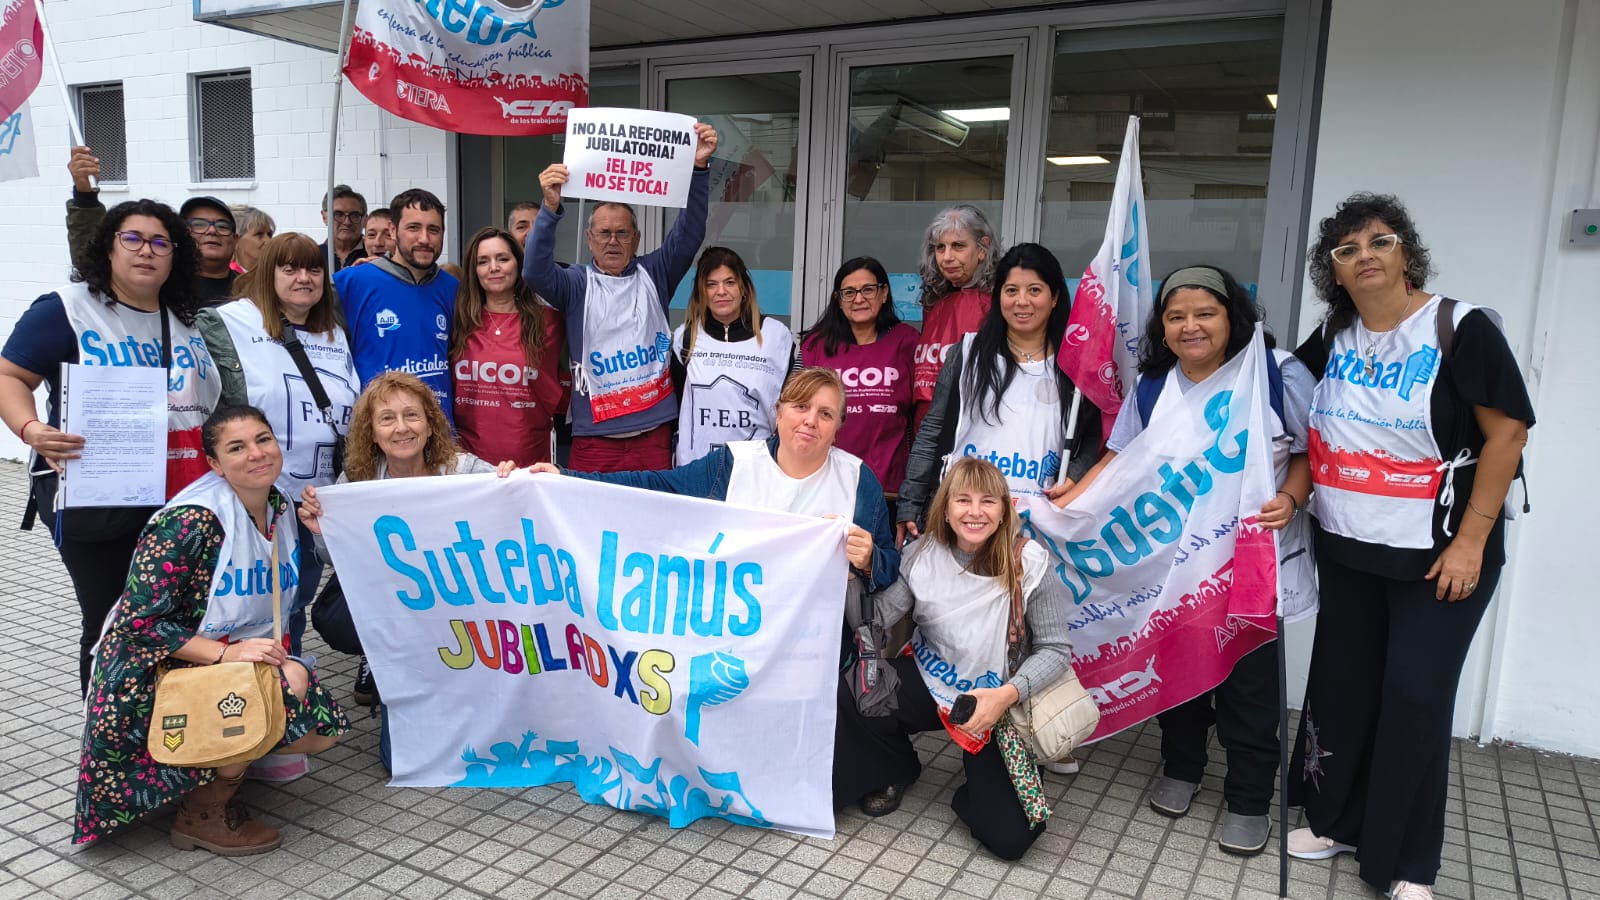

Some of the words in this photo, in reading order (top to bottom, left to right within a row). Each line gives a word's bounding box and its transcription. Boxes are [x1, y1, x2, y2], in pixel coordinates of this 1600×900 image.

[507, 43, 553, 61] pública
[396, 80, 452, 114] CTERA
[505, 100, 575, 116] CTA
[531, 117, 566, 125] trabajador
[573, 123, 596, 136] ¡NO
[599, 124, 608, 136] A
[609, 123, 627, 138] LA
[629, 125, 691, 146] REFORMA
[586, 137, 675, 160] JUBILATORIA!
[606, 157, 628, 175] ¡EL
[630, 160, 653, 177] IPS
[585, 173, 606, 189] NO
[608, 176, 626, 191] SE
[628, 178, 669, 196] TOCA!
[252, 336, 264, 344] La
[590, 345, 657, 377] Suteba
[709, 351, 767, 363] transformadora
[914, 342, 956, 364] CIC
[455, 360, 538, 386] CICOP
[834, 366, 900, 388] COP
[1325, 348, 1402, 389] uteba
[461, 397, 500, 407] FESINTRAS
[699, 407, 757, 429] F.E.B.
[1347, 410, 1392, 428] Educación
[1395, 418, 1426, 431] Públi
[964, 444, 1039, 480] teba
[373, 514, 584, 618] Suteba
[437, 619, 675, 716] JUBILADXS
